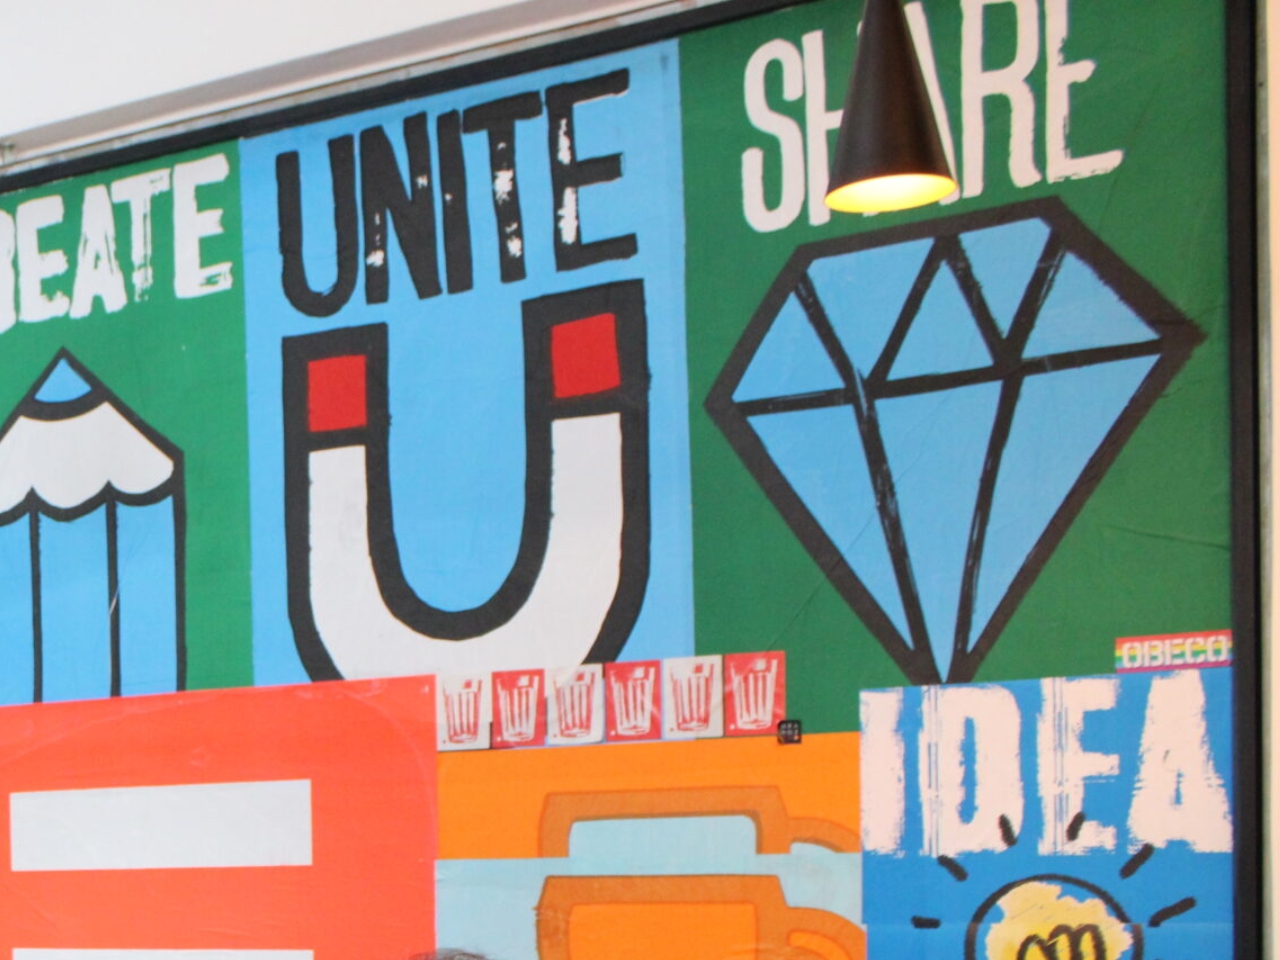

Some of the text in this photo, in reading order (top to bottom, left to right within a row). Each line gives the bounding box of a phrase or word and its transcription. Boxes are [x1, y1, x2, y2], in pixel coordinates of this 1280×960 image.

[275, 68, 638, 318] UNITE
[1122, 635, 1228, 668] OBECO
[859, 669, 1233, 858] IDEA
